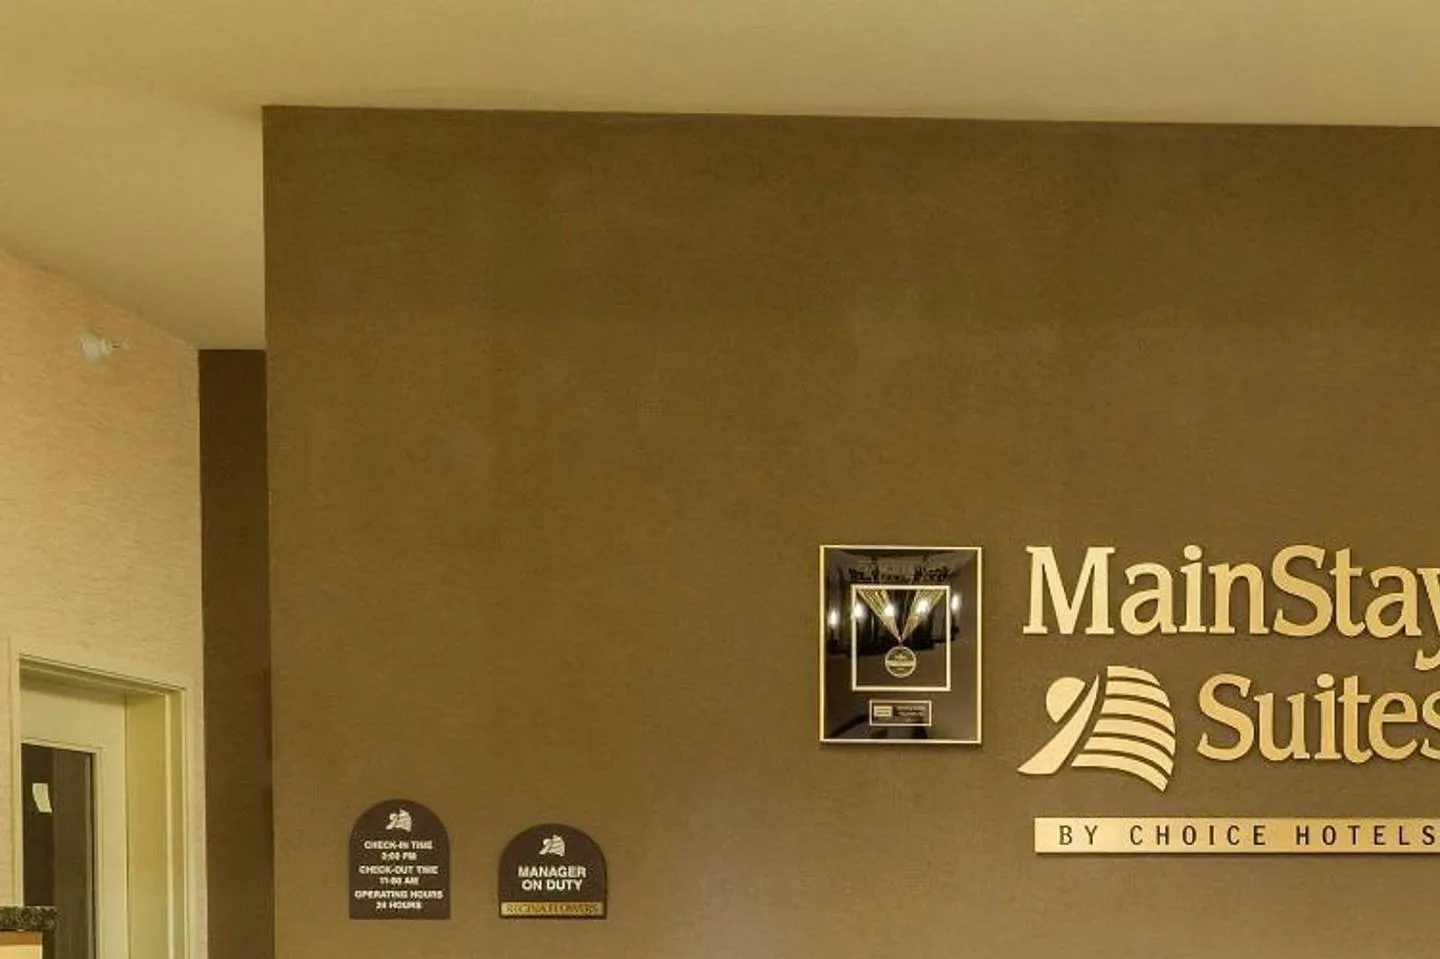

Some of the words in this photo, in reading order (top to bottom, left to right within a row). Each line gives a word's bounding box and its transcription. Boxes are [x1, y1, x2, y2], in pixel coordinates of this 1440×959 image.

[1059, 824, 1099, 846] BY
[1129, 824, 1266, 846] CHOICE
[364, 840, 409, 849] CHECK-IN
[358, 865, 413, 874] CHECK-OUT
[518, 865, 587, 878] MANAGER
[521, 879, 542, 891] ON
[546, 879, 583, 891] DUTY
[354, 890, 408, 899] OPERATING
[410, 890, 444, 899] HOURS
